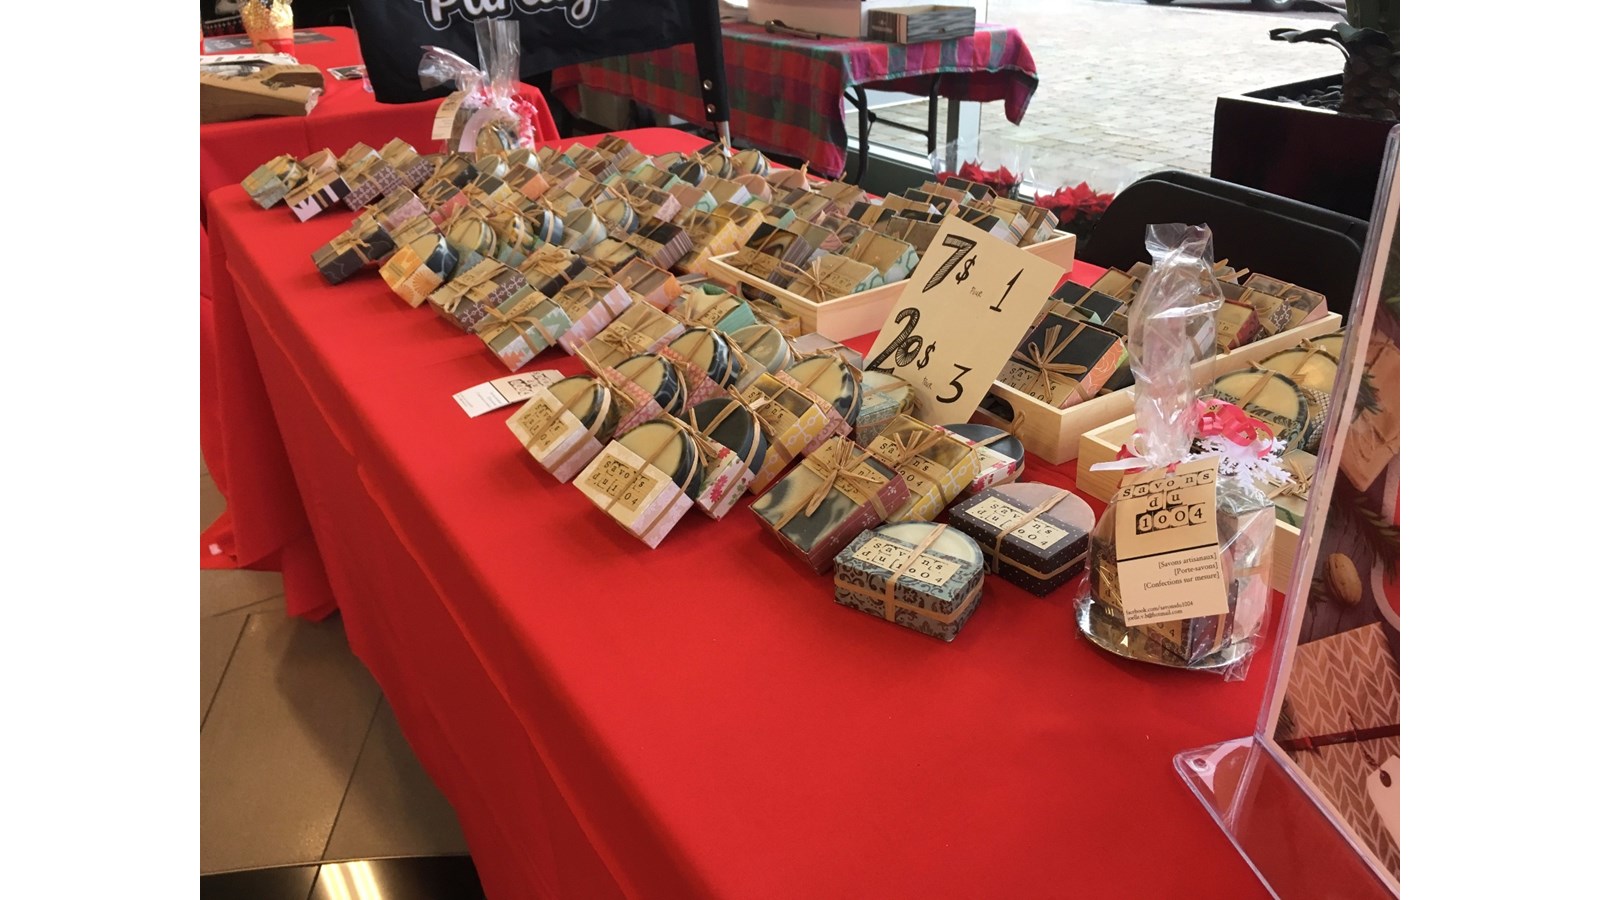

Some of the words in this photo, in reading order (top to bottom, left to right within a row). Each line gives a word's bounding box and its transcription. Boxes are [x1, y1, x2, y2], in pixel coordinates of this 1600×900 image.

[922, 233, 978, 294] 7$
[935, 363, 974, 404] 3
[610, 484, 639, 506] 104
[1149, 492, 1182, 508] du
[990, 503, 1053, 535] savns
[1141, 507, 1204, 530] 1004
[861, 550, 887, 563] du
[873, 542, 944, 571] savns
[1183, 575, 1193, 583] sur
